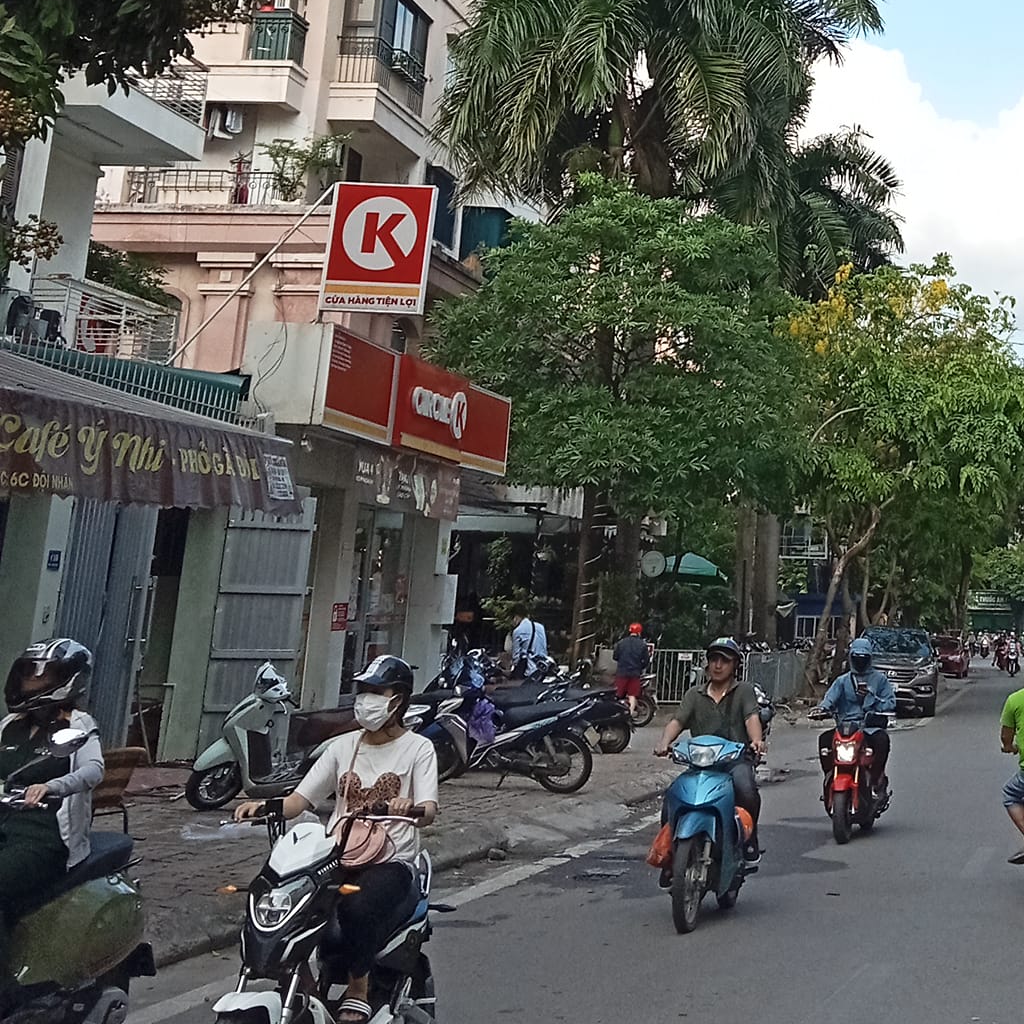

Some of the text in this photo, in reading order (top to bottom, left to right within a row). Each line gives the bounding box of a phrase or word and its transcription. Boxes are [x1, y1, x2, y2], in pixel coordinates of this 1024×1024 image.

[358, 210, 409, 268] K
[325, 295, 417, 308] CỬA HÀNG TIỆN LỢI
[412, 387, 451, 424] CIRCLE
[0, 414, 71, 463] Café
[112, 432, 167, 473] Nhi
